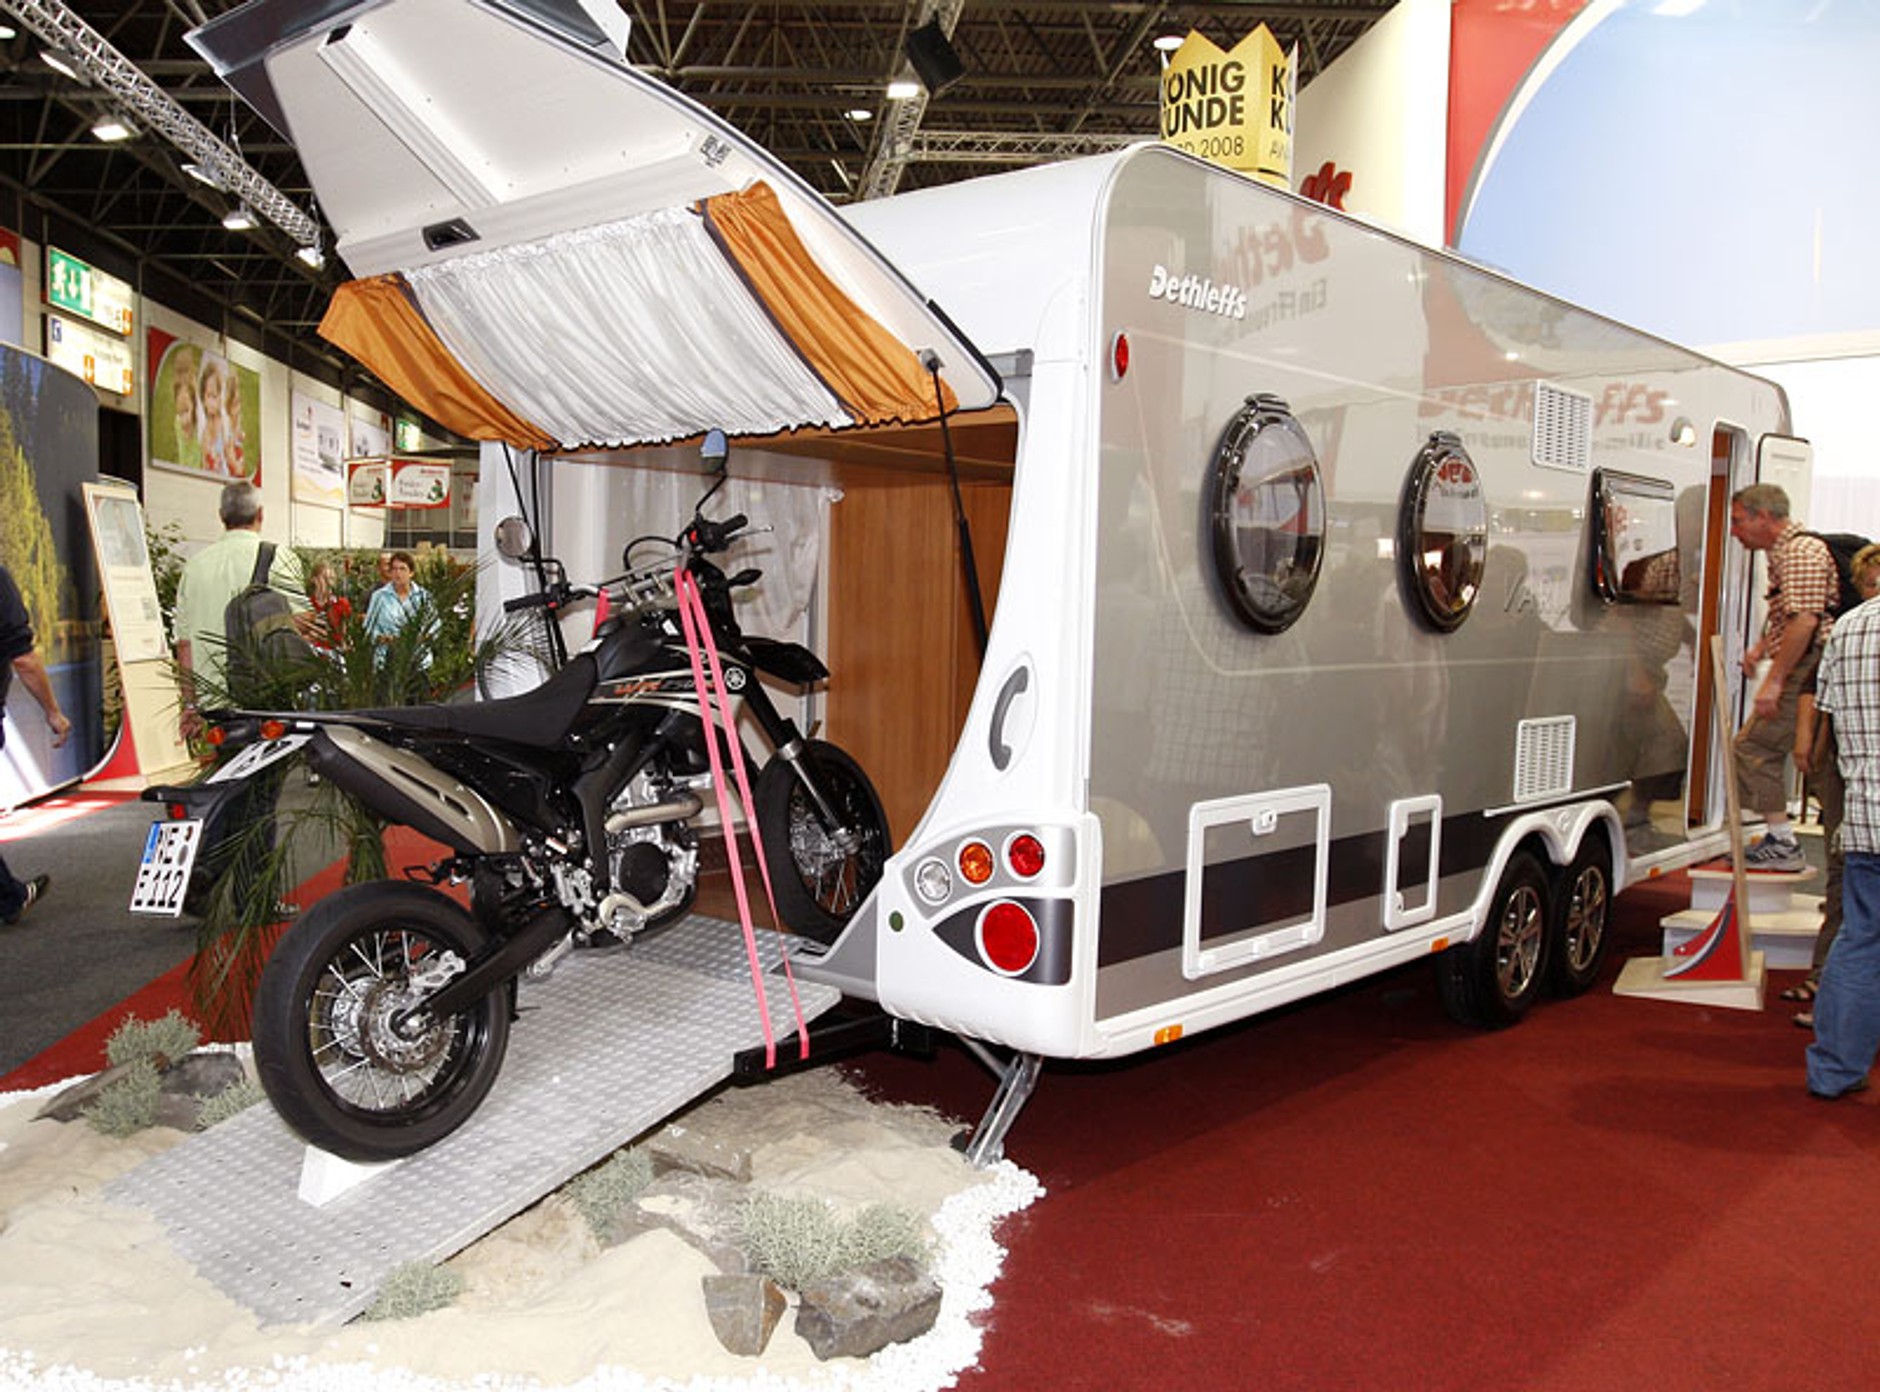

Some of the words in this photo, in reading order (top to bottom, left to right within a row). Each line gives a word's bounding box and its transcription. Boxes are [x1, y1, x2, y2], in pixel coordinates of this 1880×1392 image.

[1162, 95, 1245, 140] UNDE
[1200, 136, 1245, 159] 2008
[1148, 264, 1249, 320] Dethleffs
